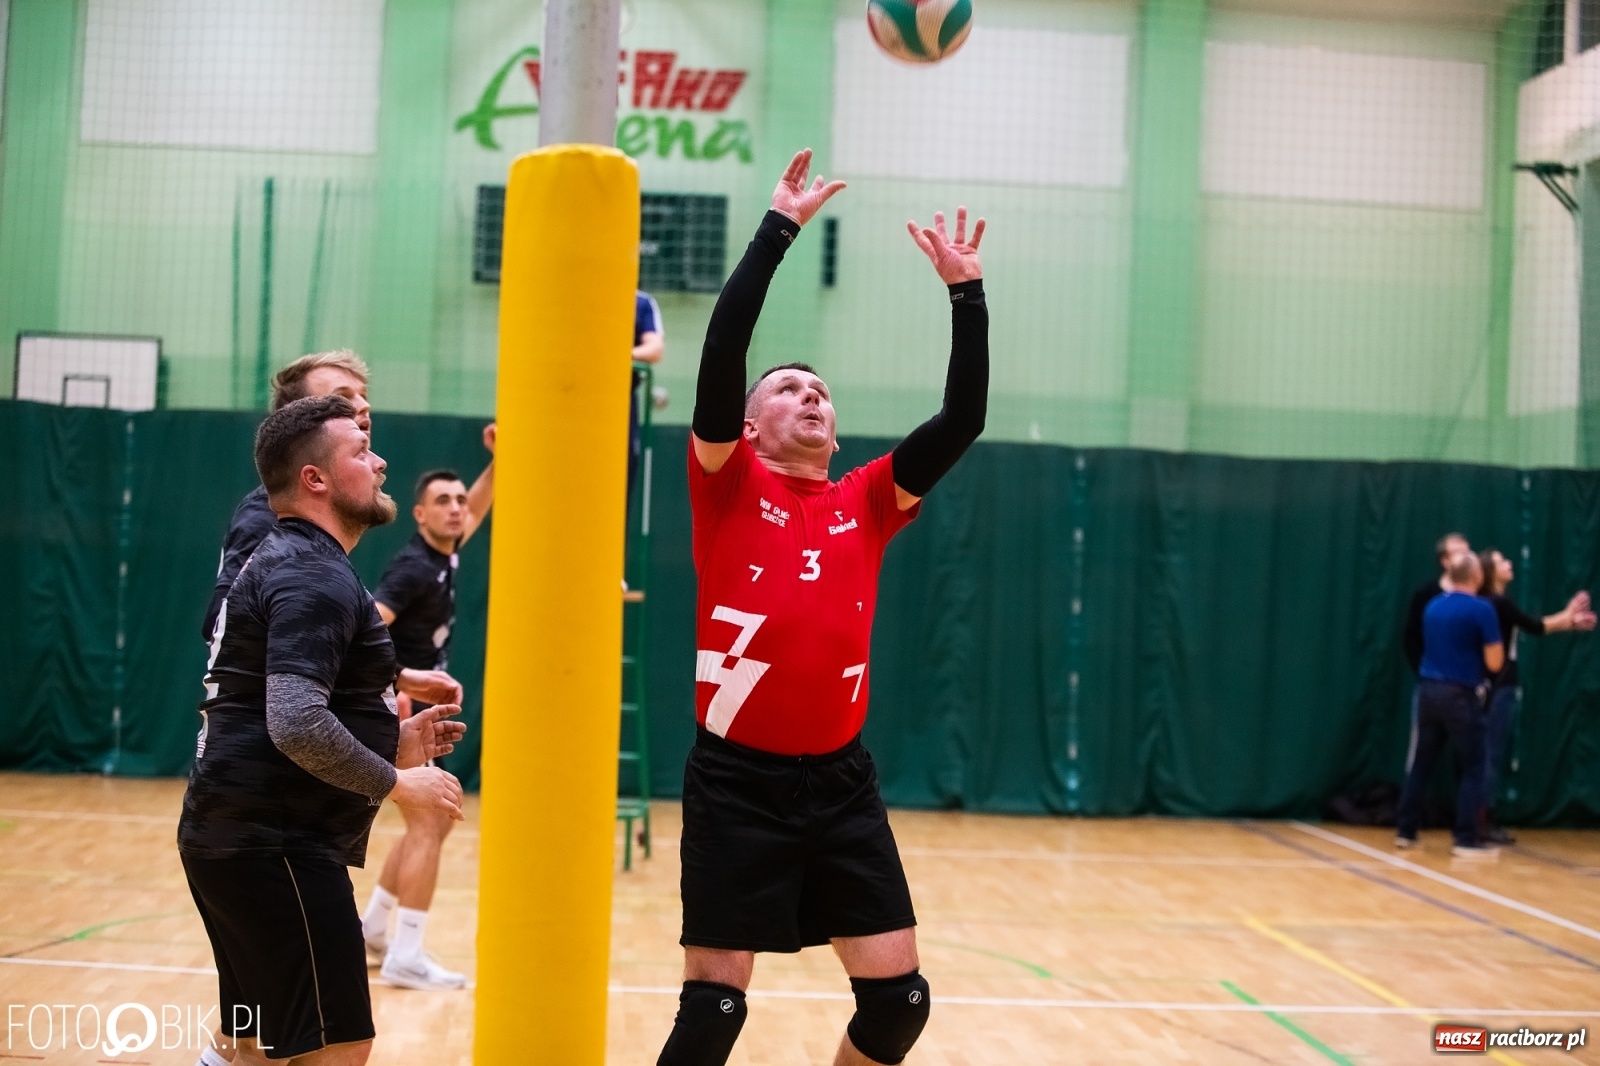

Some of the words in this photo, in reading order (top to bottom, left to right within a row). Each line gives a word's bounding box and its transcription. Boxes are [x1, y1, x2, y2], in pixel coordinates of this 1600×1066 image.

[454, 45, 754, 163] Aena
[748, 564, 764, 582] 7
[798, 549, 822, 581] 3
[711, 605, 768, 671] 7
[842, 662, 867, 703] 7
